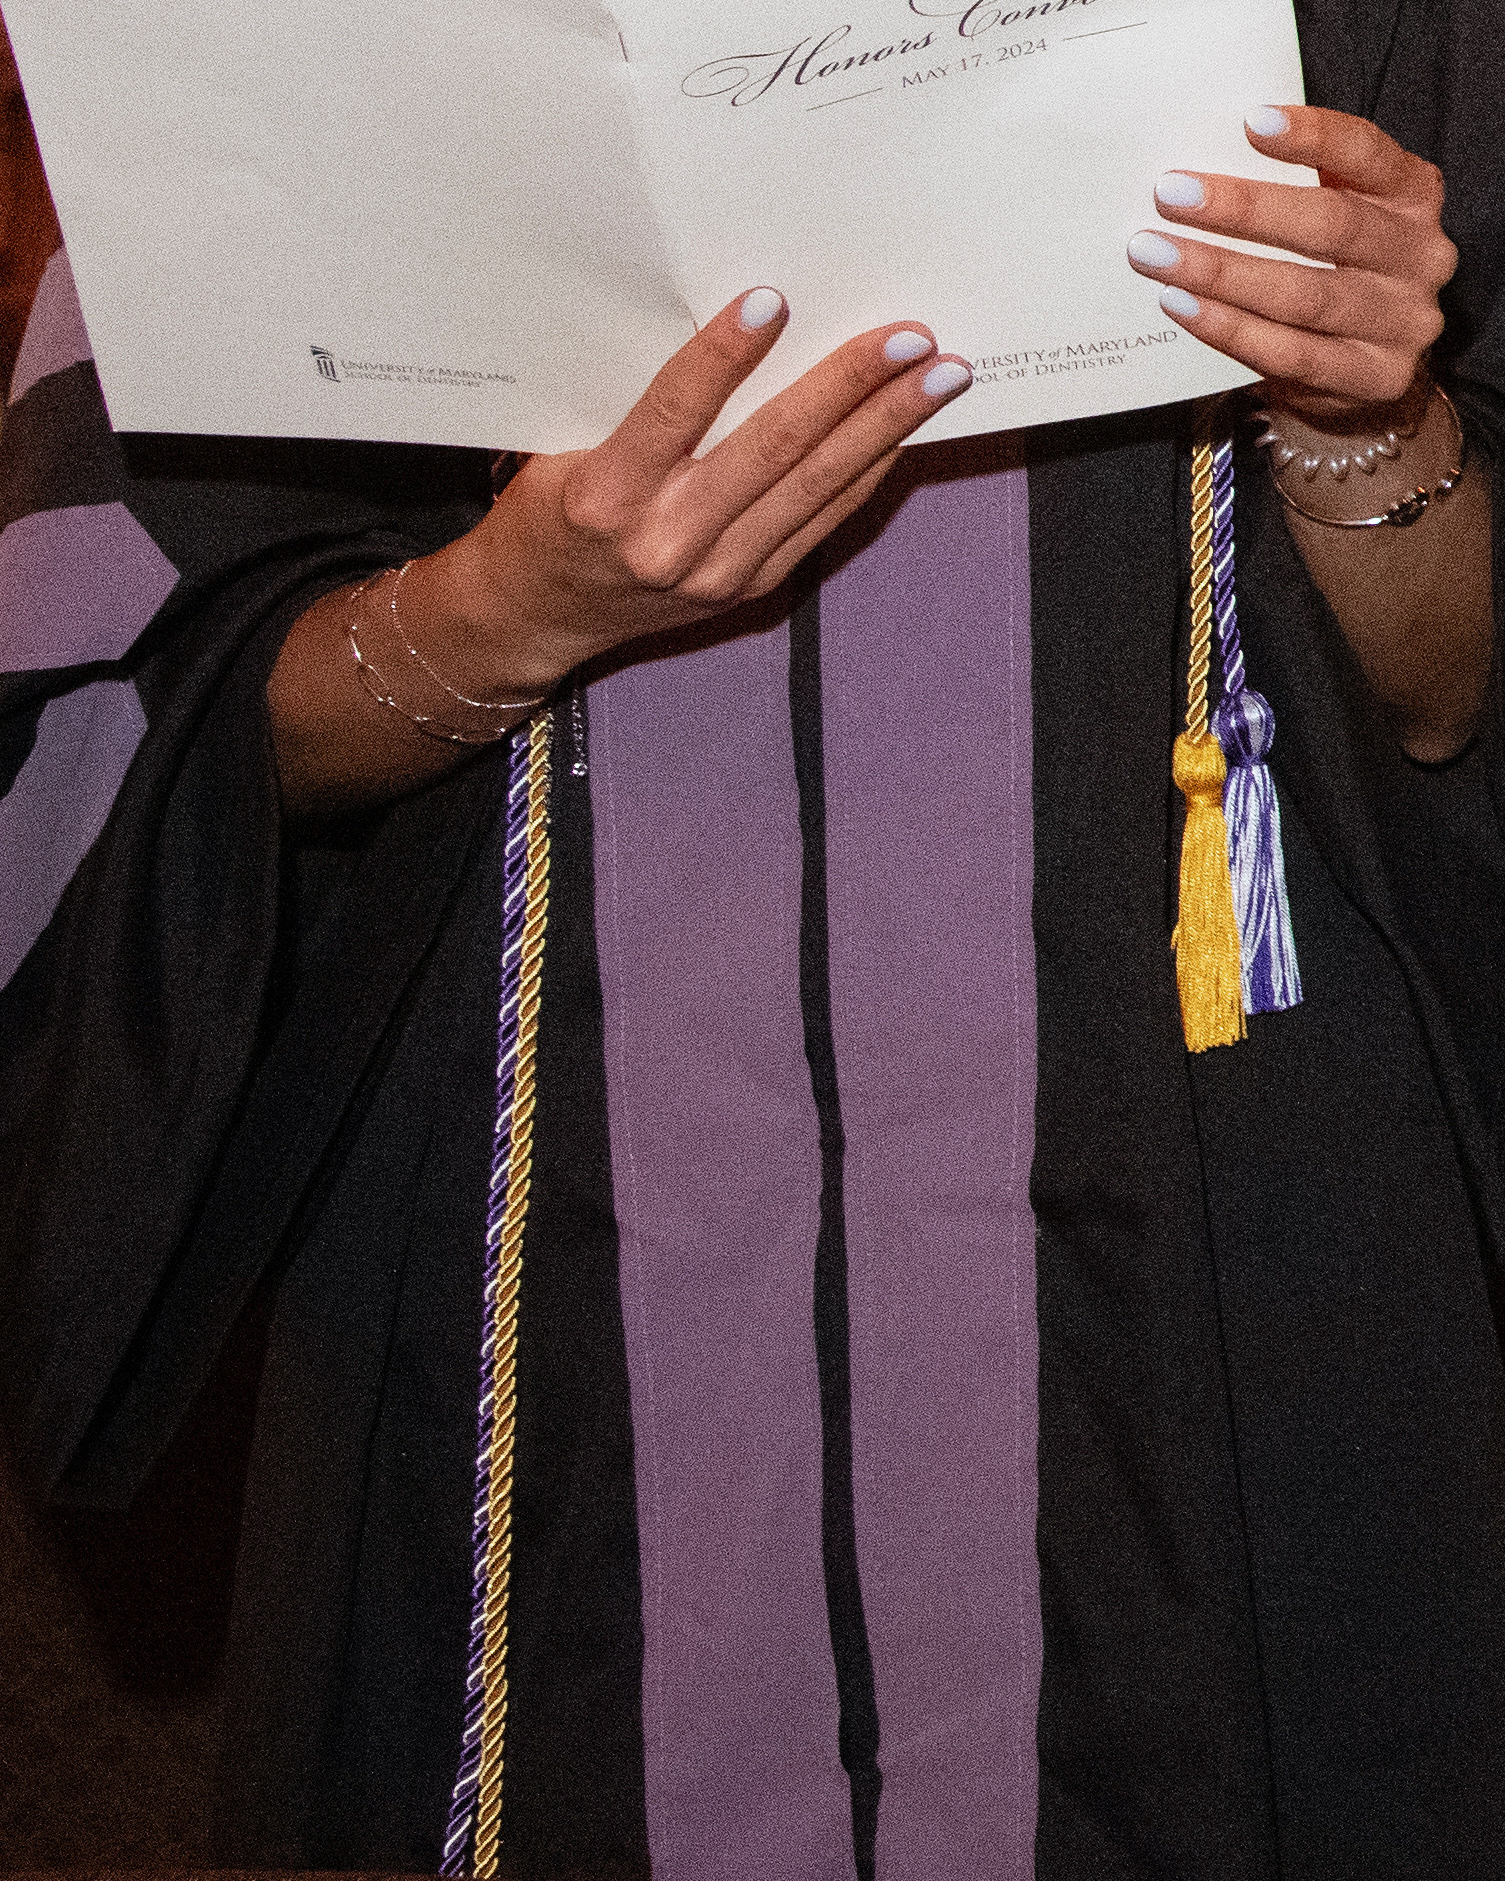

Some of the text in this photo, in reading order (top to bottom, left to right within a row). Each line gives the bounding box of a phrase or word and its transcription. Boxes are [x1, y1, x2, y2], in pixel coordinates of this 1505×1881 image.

[682, 24, 938, 107] Honors
[901, 64, 948, 89] MAY
[998, 37, 1048, 65] 2024
[969, 330, 1178, 371] VERSITY of MARYLAND
[1007, 368, 1028, 380] OF
[1035, 354, 1125, 376] DENTISTRY
[341, 359, 423, 374] UNIVERSITY
[438, 367, 516, 384] MARYLAND
